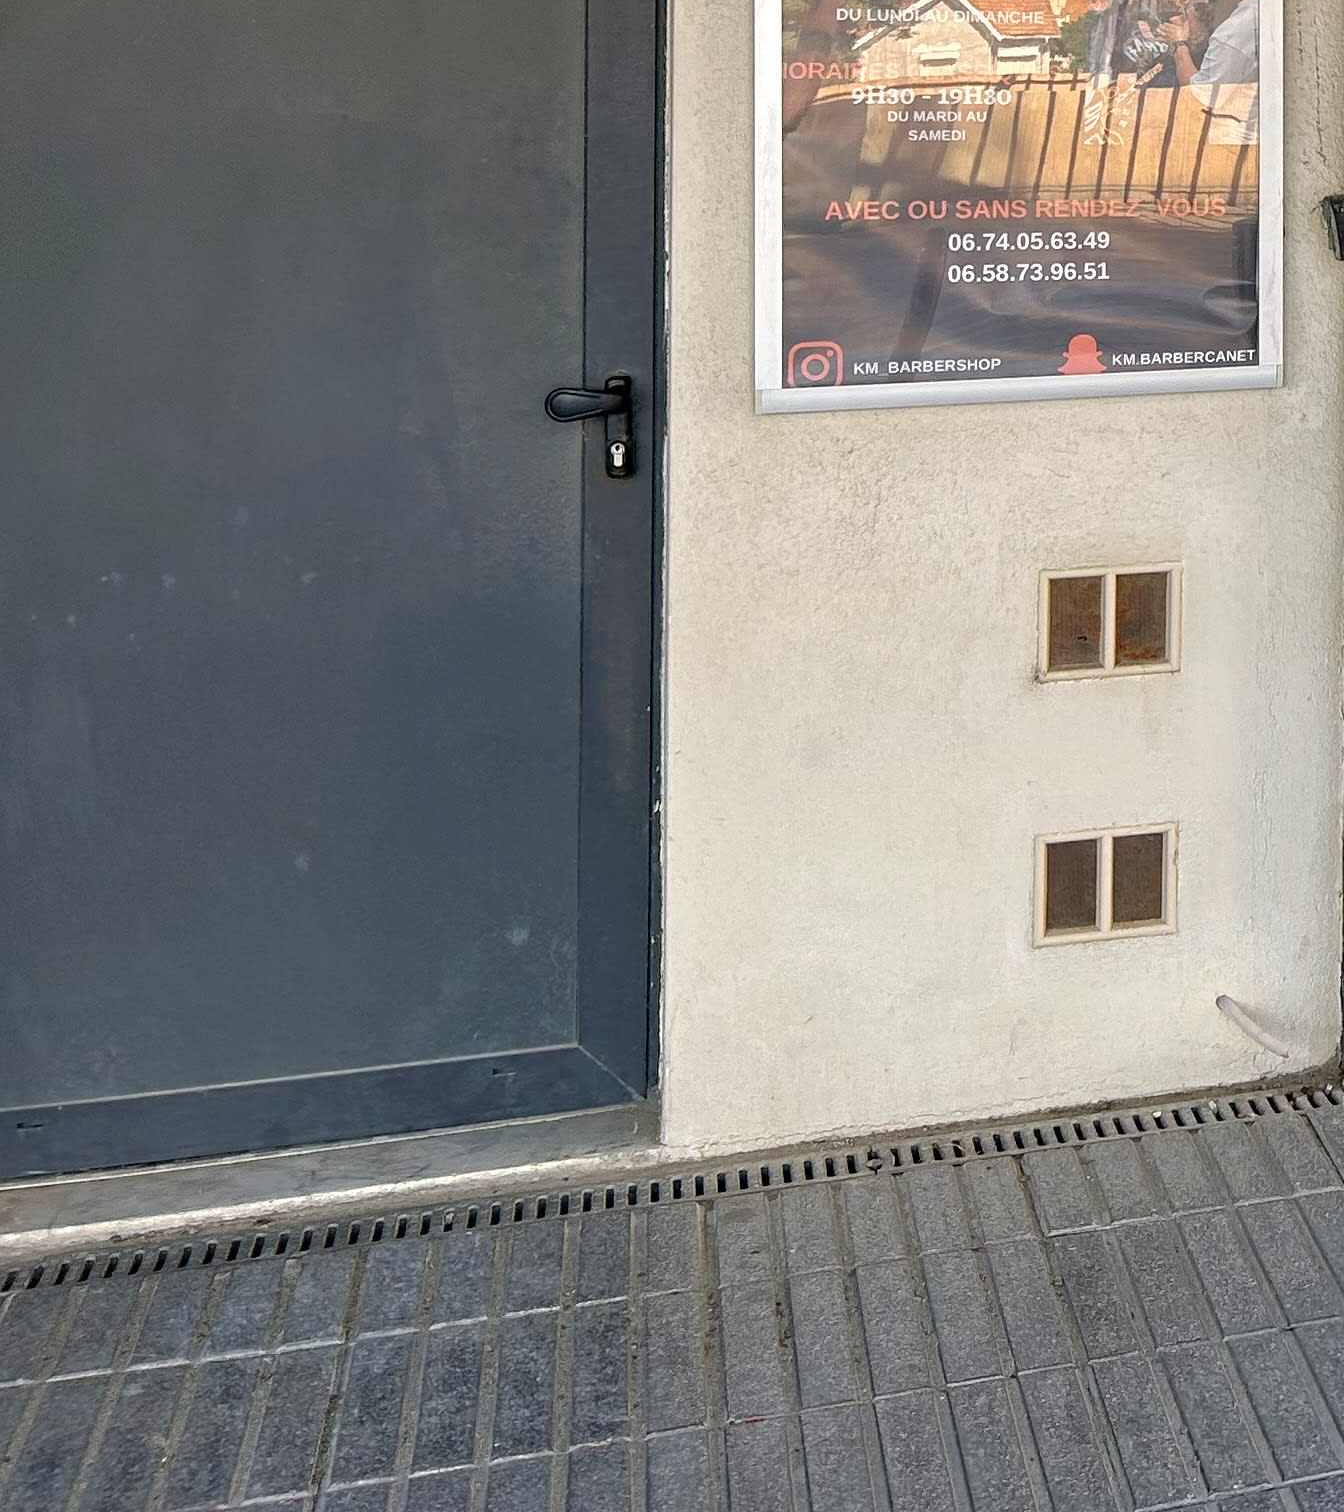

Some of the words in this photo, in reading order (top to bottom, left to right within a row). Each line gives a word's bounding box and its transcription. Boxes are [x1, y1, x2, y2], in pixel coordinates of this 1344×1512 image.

[836, 8, 862, 22] DU
[867, 8, 922, 23] LUNDI
[926, 10, 949, 23] AU
[953, 10, 1045, 25] DIMANCHE
[851, 87, 916, 105] 9H30
[887, 111, 909, 123] DU
[913, 111, 962, 123] MARDI
[966, 111, 988, 122] AU
[907, 130, 967, 142] SAMEDI
[824, 201, 900, 221] AVEC
[907, 200, 948, 220] OU
[955, 199, 1027, 220] SANS
[948, 231, 1111, 251] 06.74.05.63.49
[947, 262, 1111, 283] 06.58.73.96.51
[1112, 349, 1256, 366] KM.BARBERCANET
